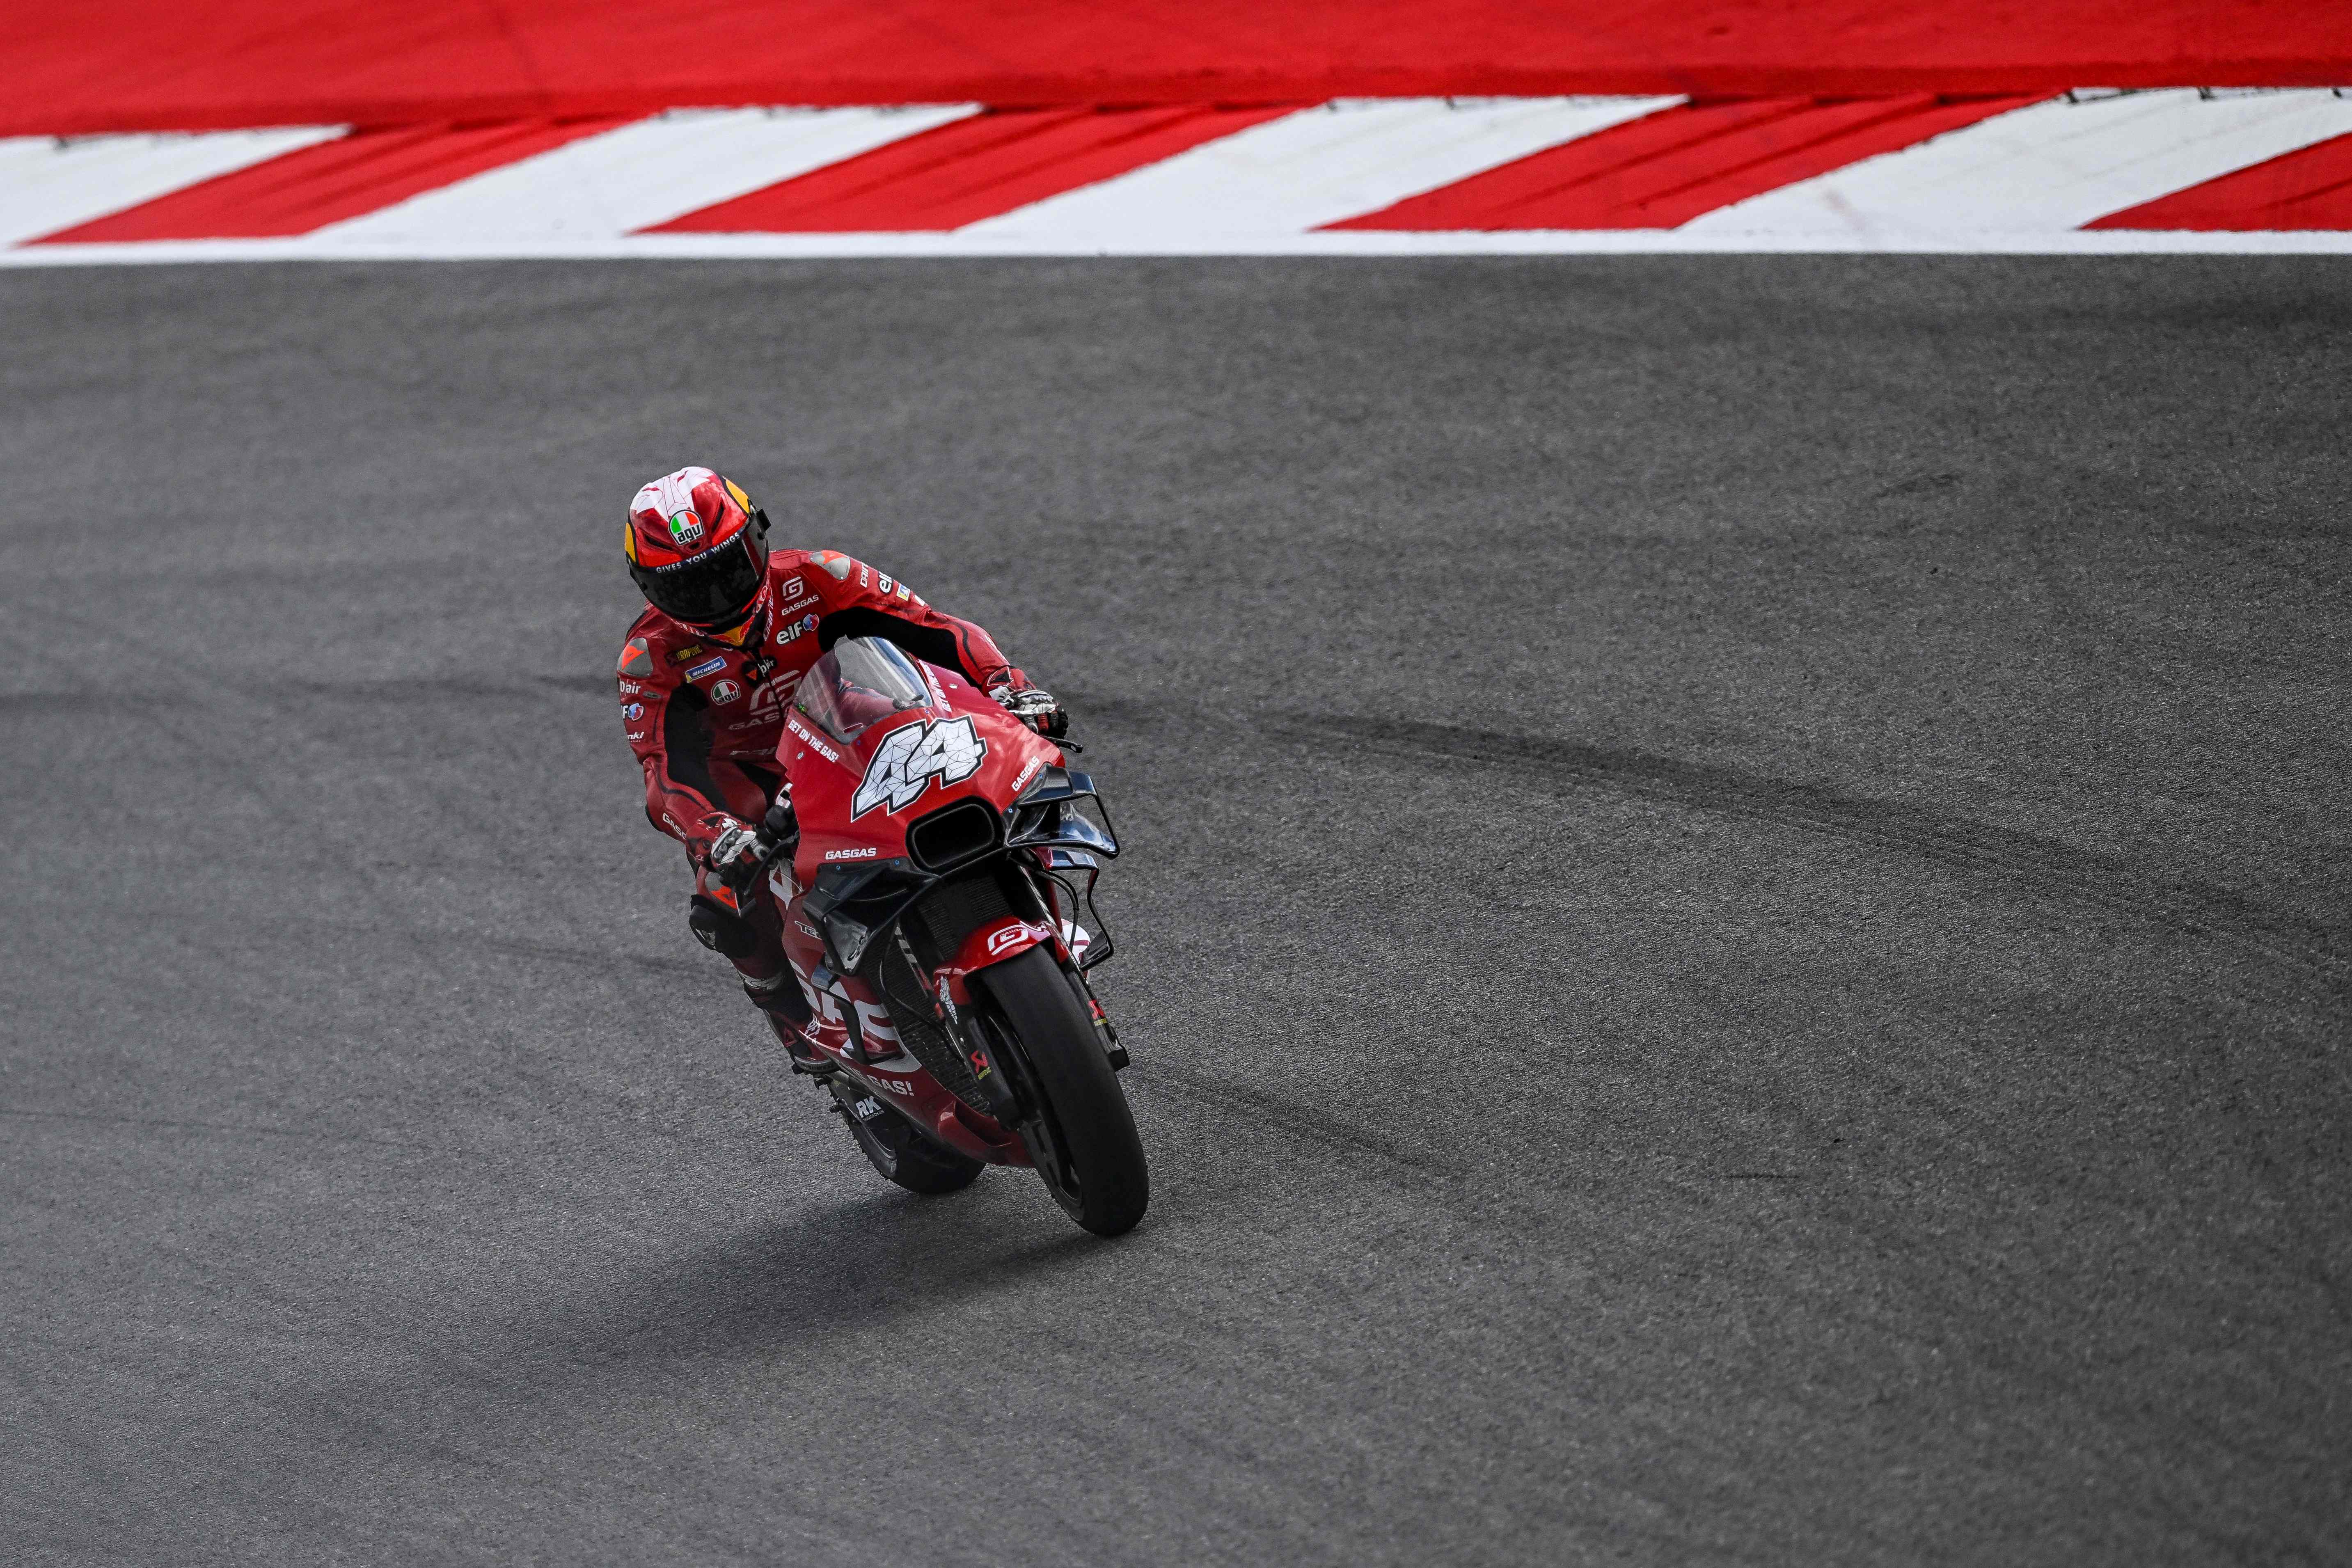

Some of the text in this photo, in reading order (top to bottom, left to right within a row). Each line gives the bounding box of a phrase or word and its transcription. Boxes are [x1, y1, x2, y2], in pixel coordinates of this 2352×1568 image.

[678, 524, 701, 543] agv
[656, 532, 740, 573] GIVES YOU WINGS
[781, 595, 819, 616] GASGAS
[776, 621, 802, 645] elf
[692, 661, 721, 677] MICHELIN
[719, 691, 736, 703] agv
[788, 719, 839, 763] GET ON THE GAS!
[850, 714, 988, 823] 44
[1012, 756, 1040, 792] GASGAS
[825, 848, 877, 860] GASGAS
[867, 1074, 914, 1096] GAS!
[856, 1096, 882, 1118] RK
